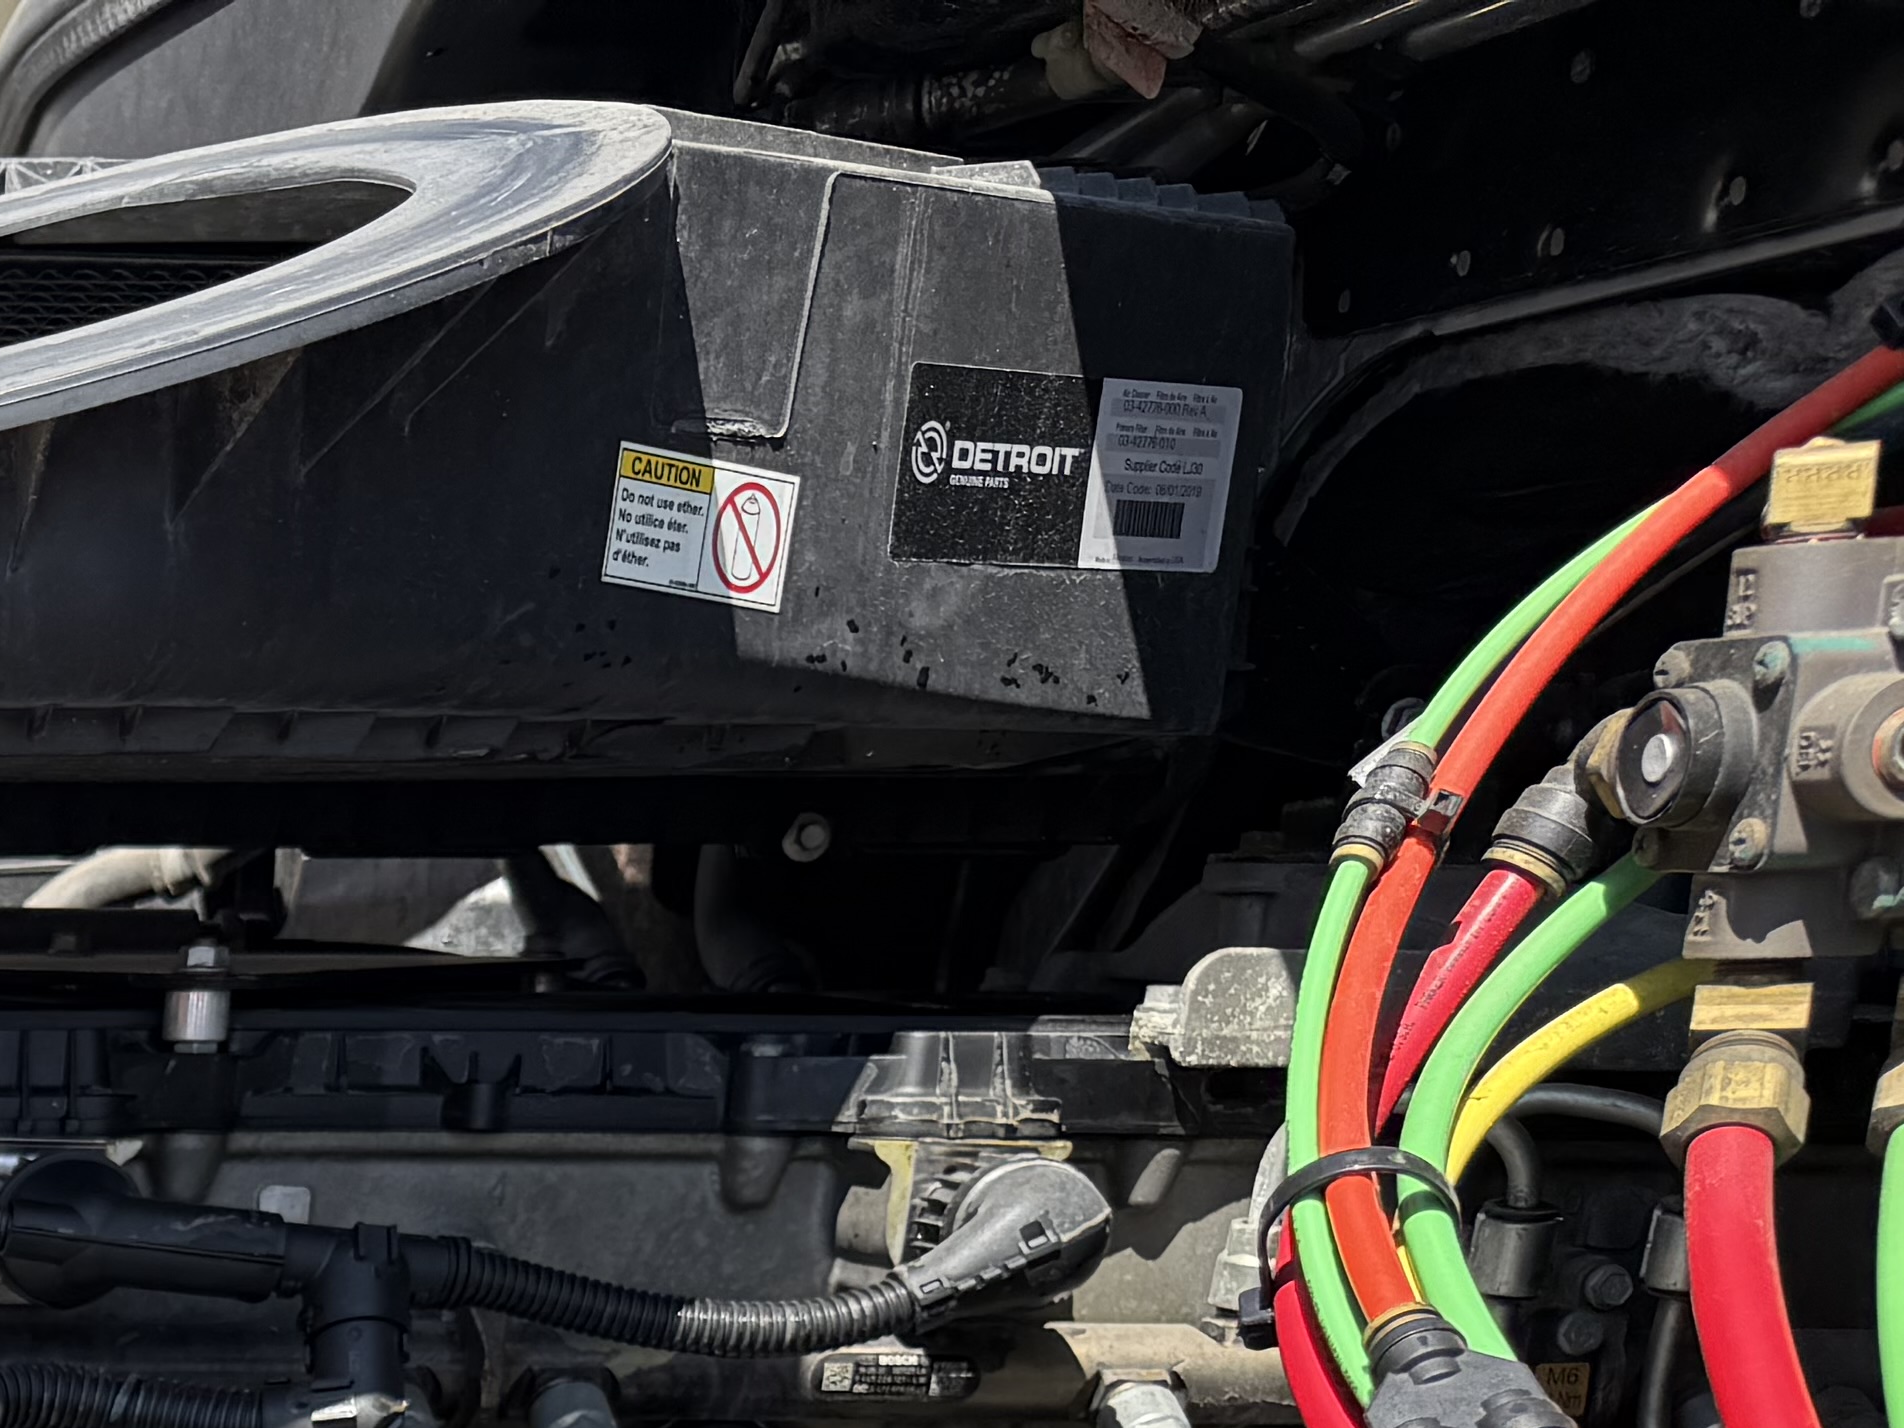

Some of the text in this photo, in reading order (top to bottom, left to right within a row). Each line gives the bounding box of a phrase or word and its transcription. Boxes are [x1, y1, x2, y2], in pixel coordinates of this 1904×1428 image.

[952, 440, 1080, 475] DETROIT
[1124, 458, 1158, 472] Supplier
[631, 456, 702, 488] CAUTION
[621, 488, 705, 516] Do not use ether.
[618, 508, 632, 523] No
[663, 540, 681, 553] pas
[1547, 1367, 1579, 1385] M6
